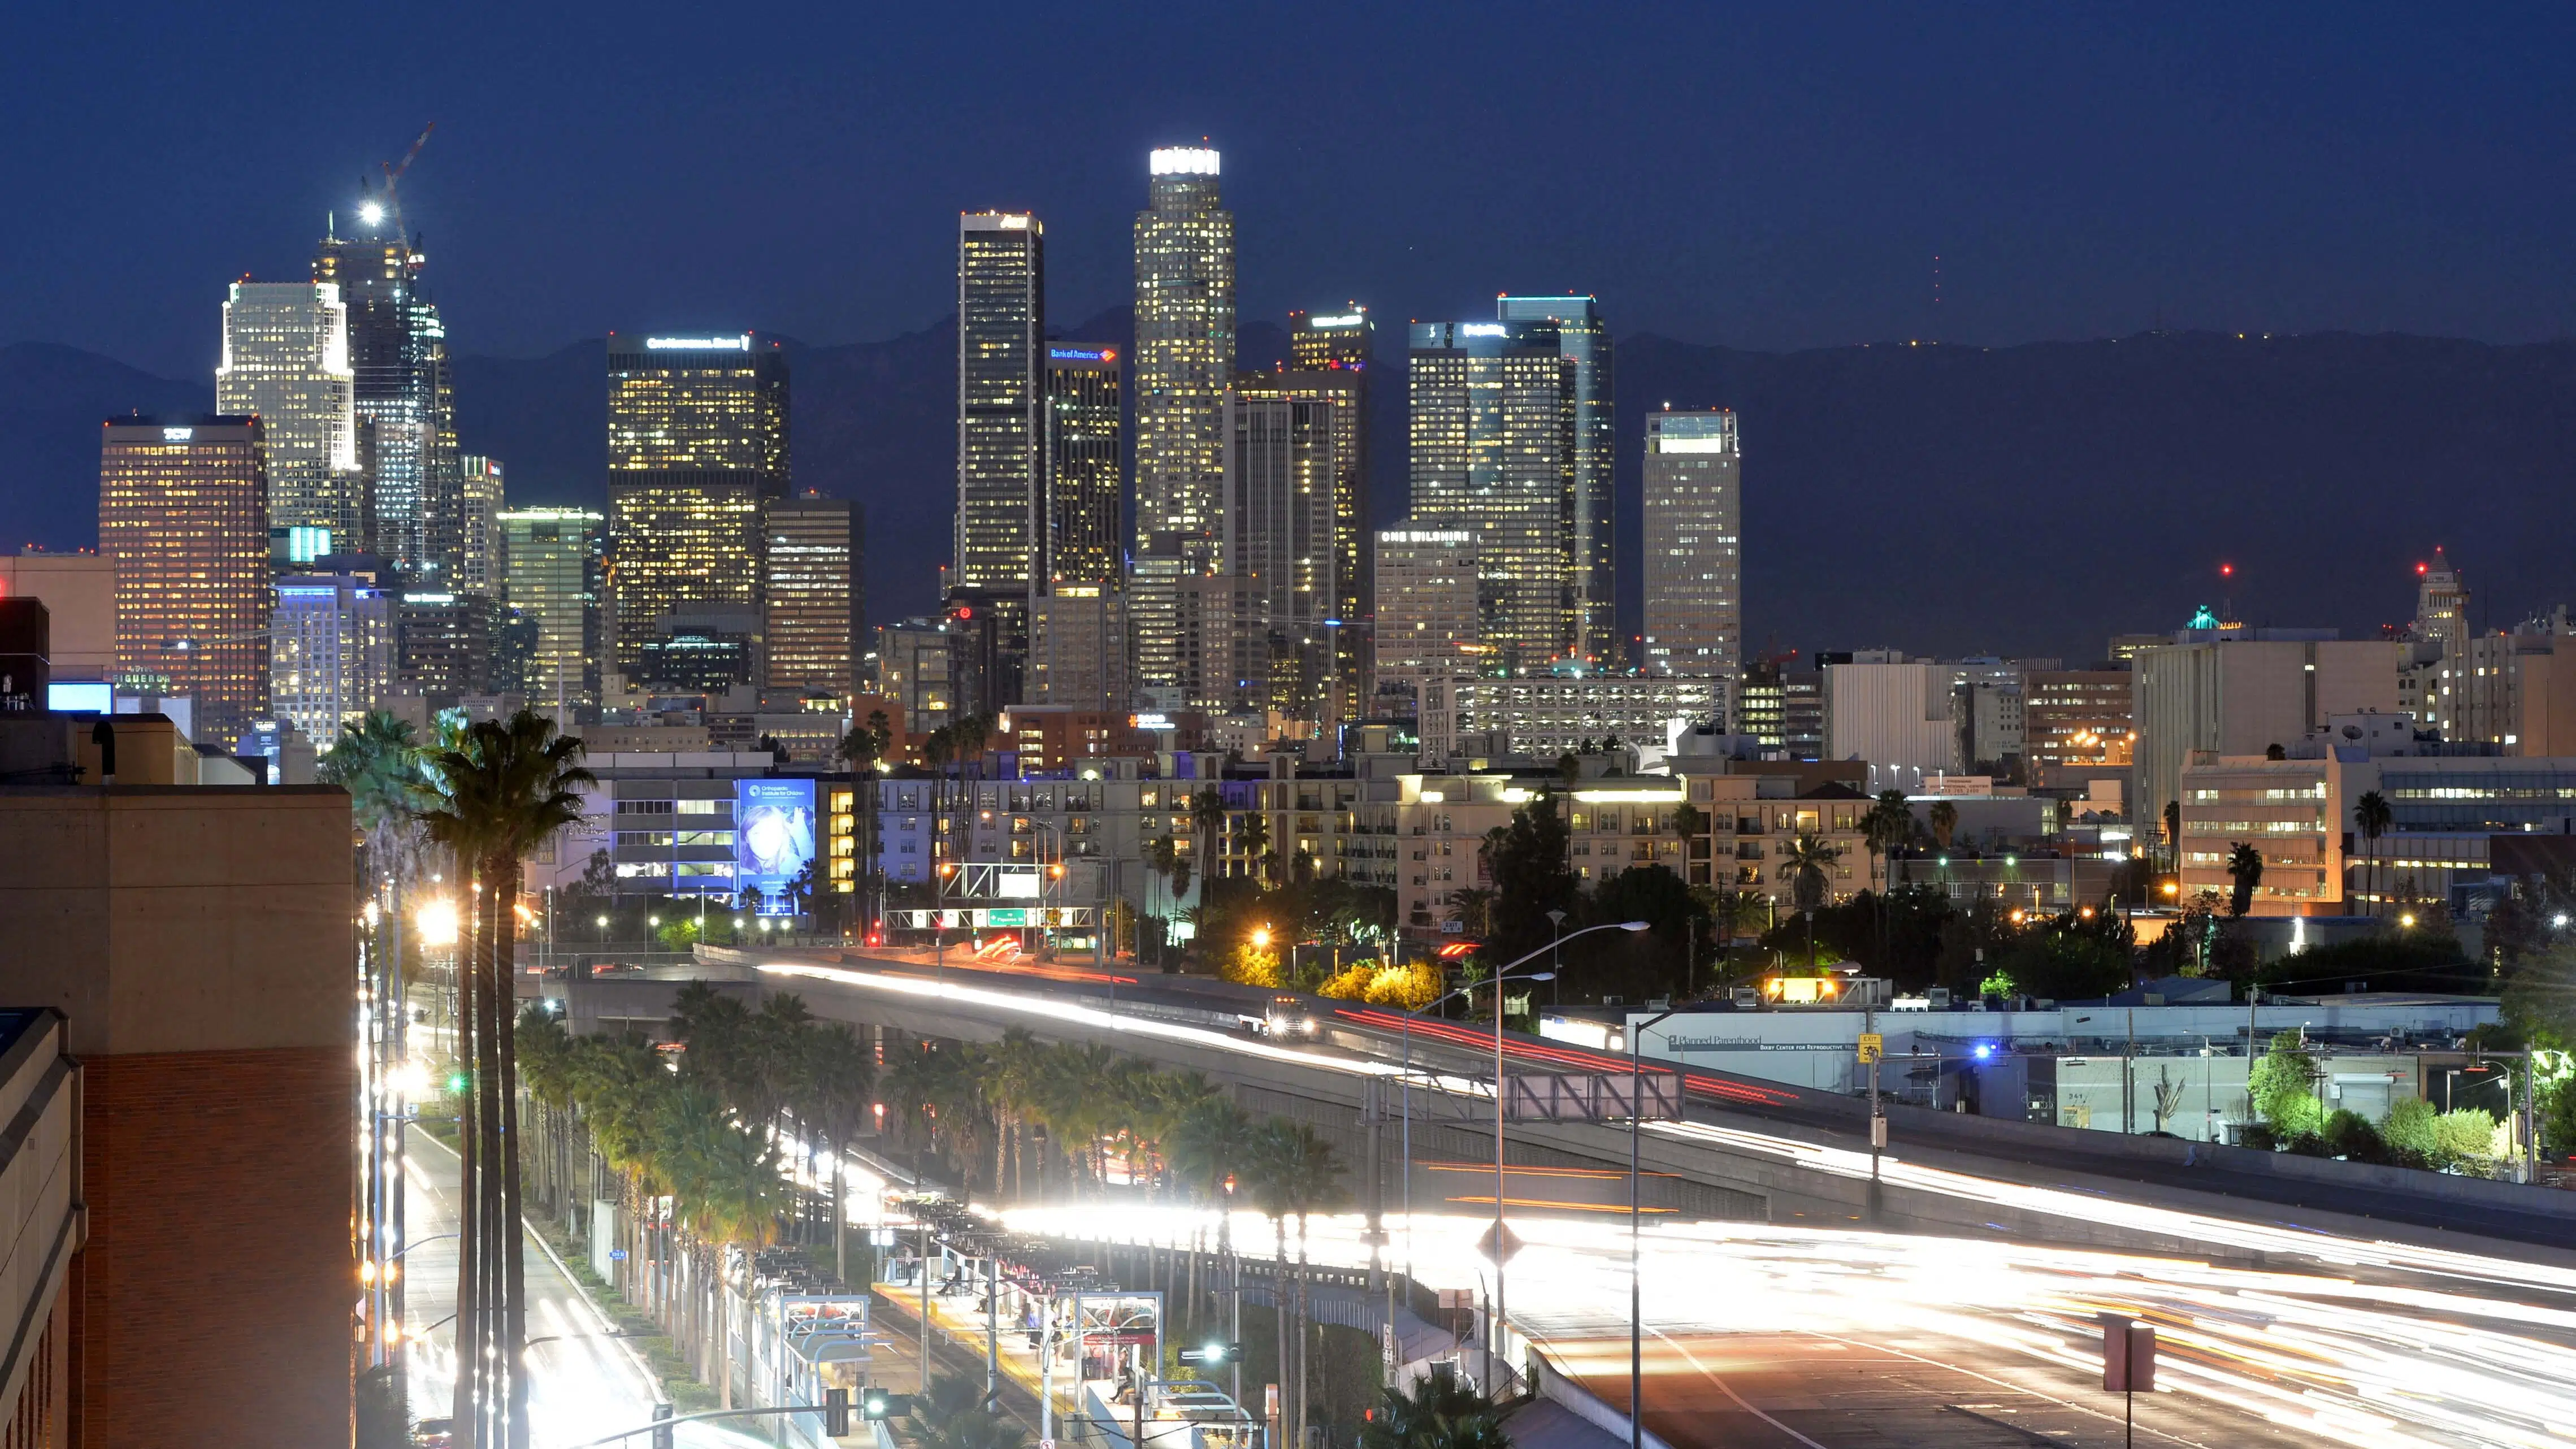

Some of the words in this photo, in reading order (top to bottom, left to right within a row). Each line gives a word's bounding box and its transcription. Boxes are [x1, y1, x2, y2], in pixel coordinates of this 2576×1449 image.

[1051, 349, 1066, 358] Bank
[1066, 350, 1073, 358] of
[1074, 350, 1099, 359] America
[1381, 531, 1407, 542] ONE
[1410, 531, 1469, 542] WILSHIRE
[112, 674, 170, 683] FIGUEROA
[1679, 1035, 1712, 1045] Planned
[1714, 1035, 1762, 1045] Parenthood
